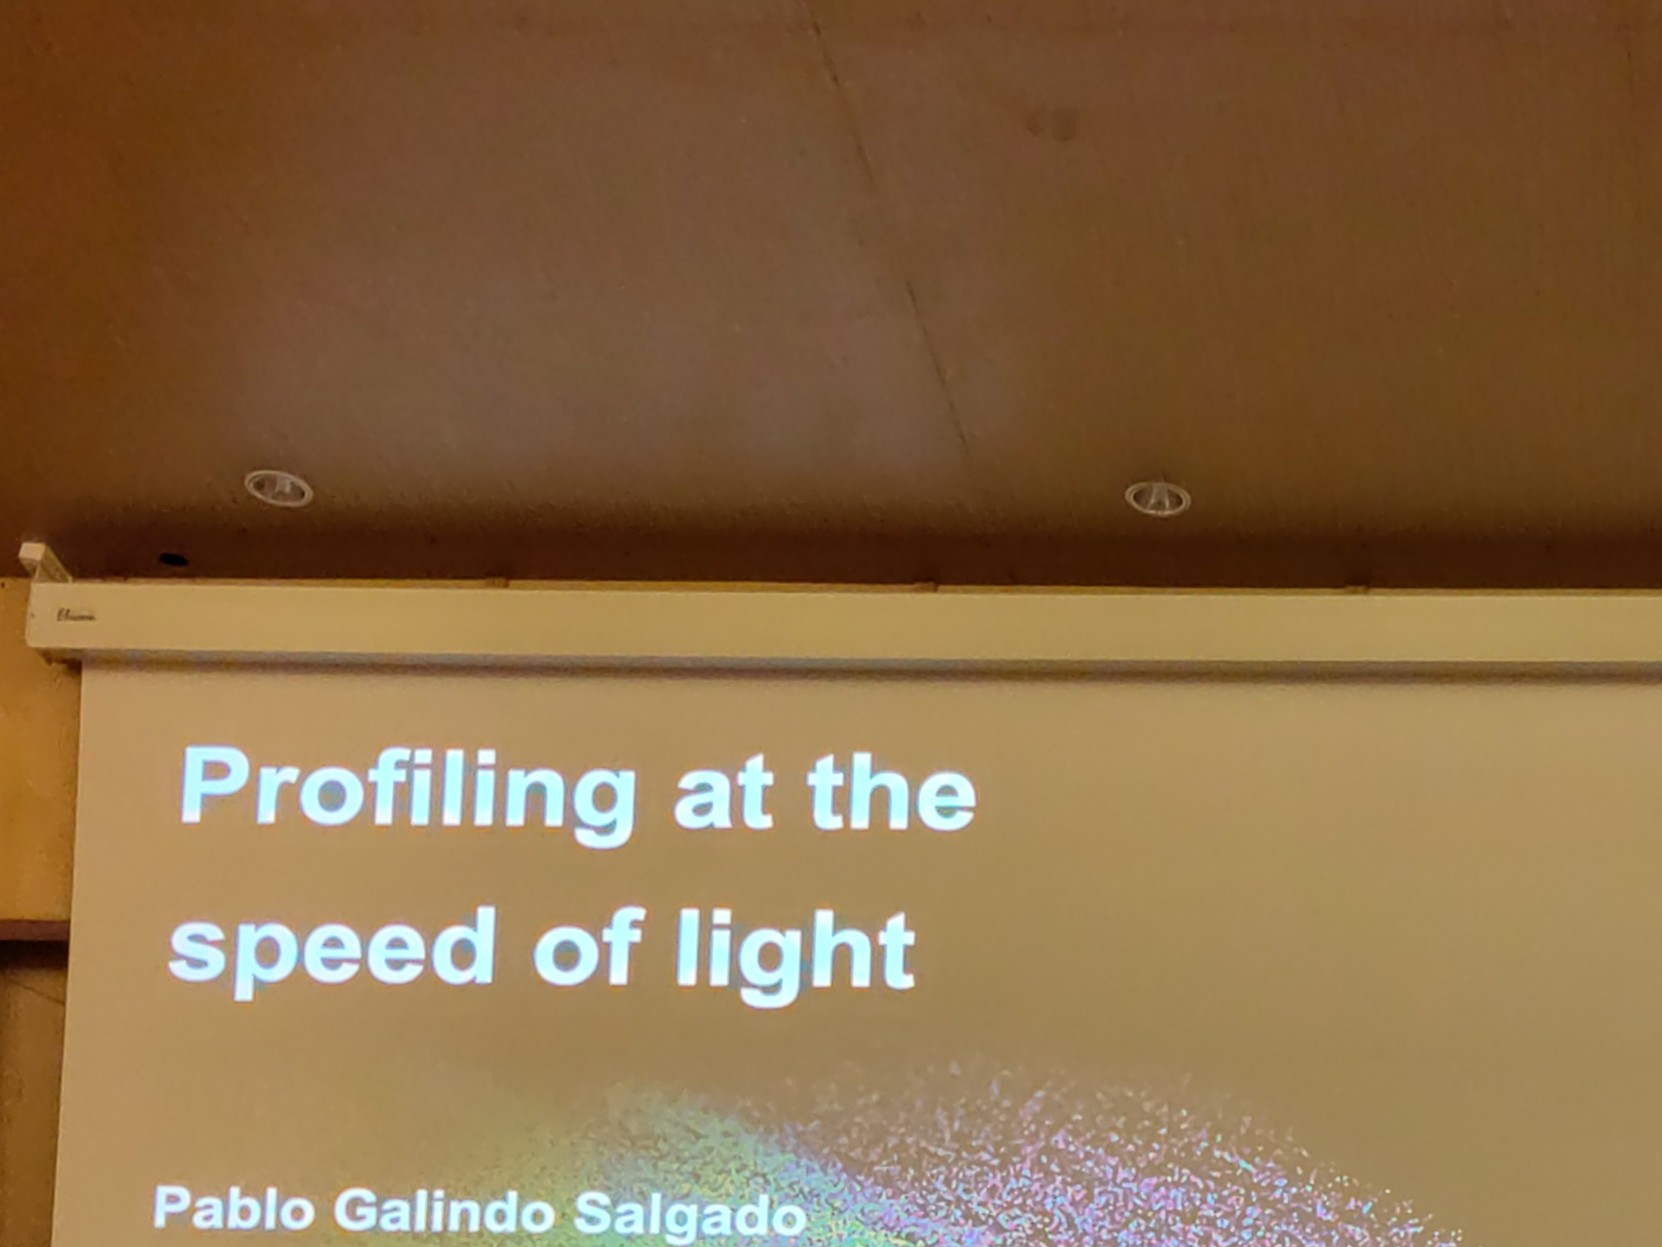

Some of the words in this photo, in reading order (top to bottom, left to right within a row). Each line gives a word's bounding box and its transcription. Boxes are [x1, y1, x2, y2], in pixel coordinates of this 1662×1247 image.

[181, 745, 636, 849] Profiling
[673, 753, 774, 830] at
[806, 751, 977, 831] the
[168, 905, 496, 1002] speed
[533, 905, 646, 986] of
[677, 908, 916, 1009] light
[153, 1185, 316, 1232] Pablo
[333, 1187, 556, 1234] Galindo
[573, 1191, 808, 1246] Salgado
